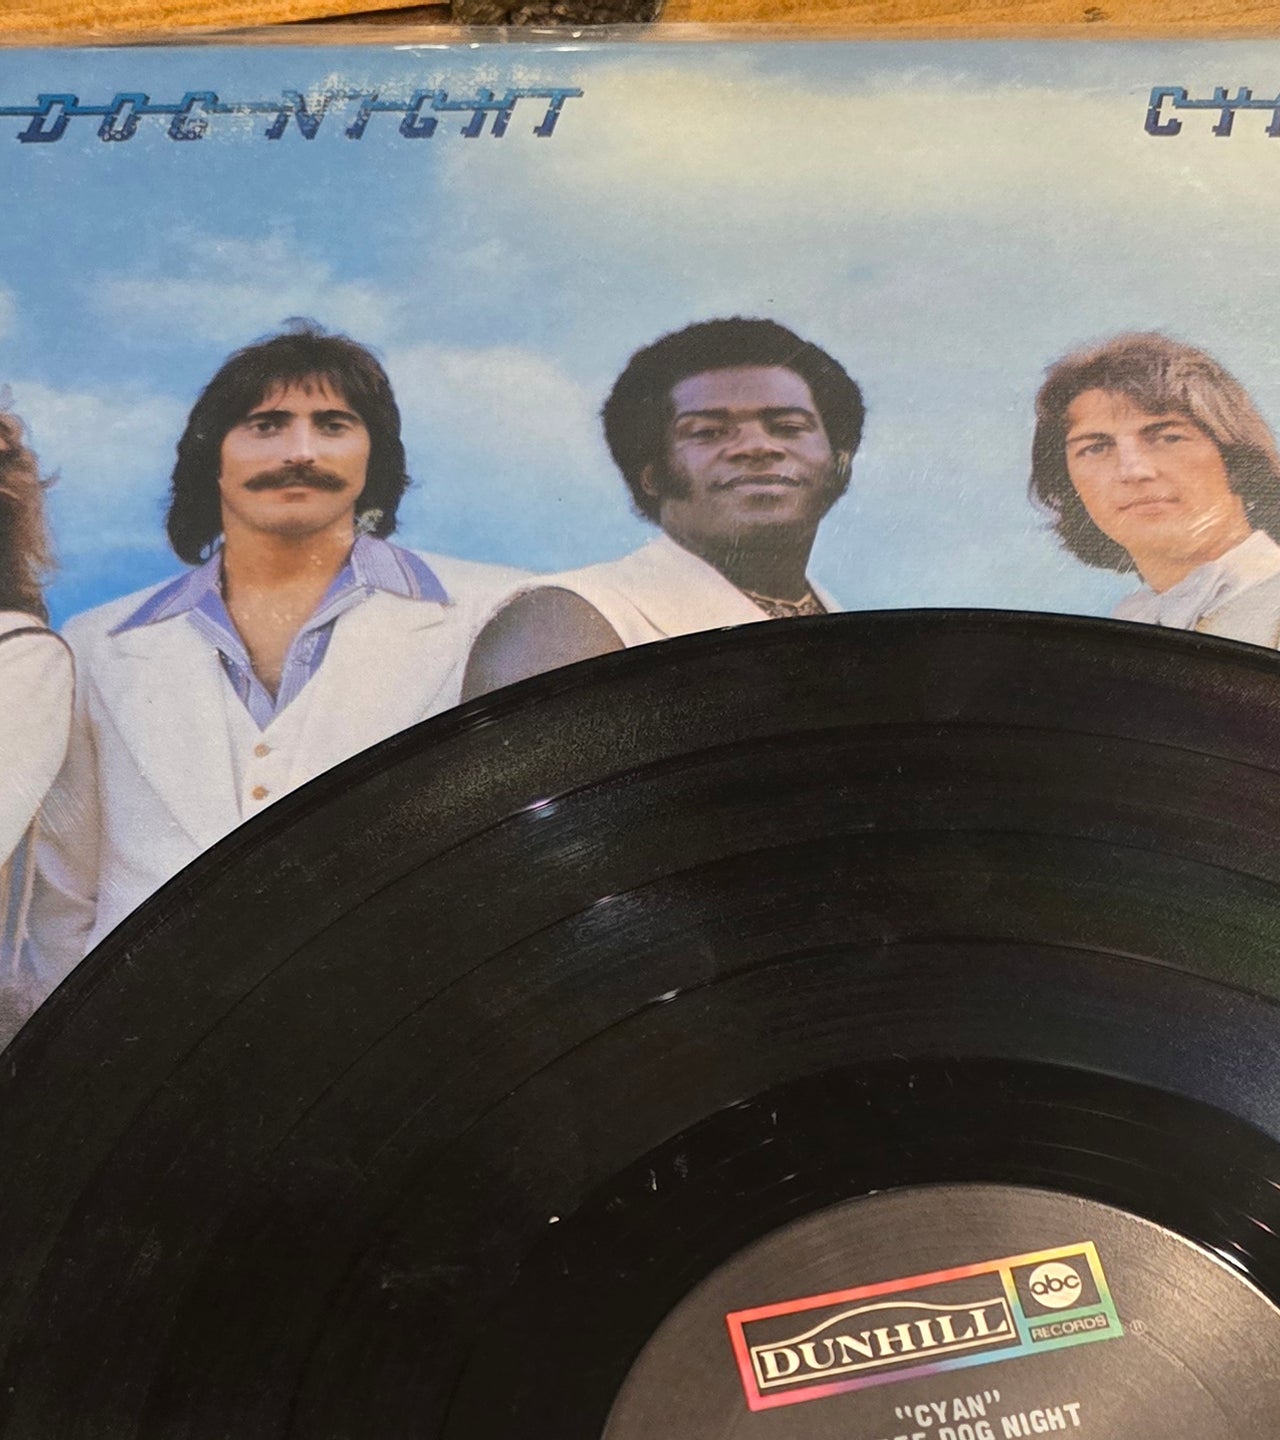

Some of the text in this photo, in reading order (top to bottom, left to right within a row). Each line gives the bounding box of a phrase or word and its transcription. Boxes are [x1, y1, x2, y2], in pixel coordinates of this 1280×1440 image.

[17, 90, 221, 143] DOG
[265, 87, 583, 141] NIGHT
[1030, 1268, 1081, 1297] abc
[758, 1308, 1009, 1381] DUNHILL
[1032, 1314, 1109, 1341] RECORDS
[1002, 1402, 1082, 1440] NIGHT
